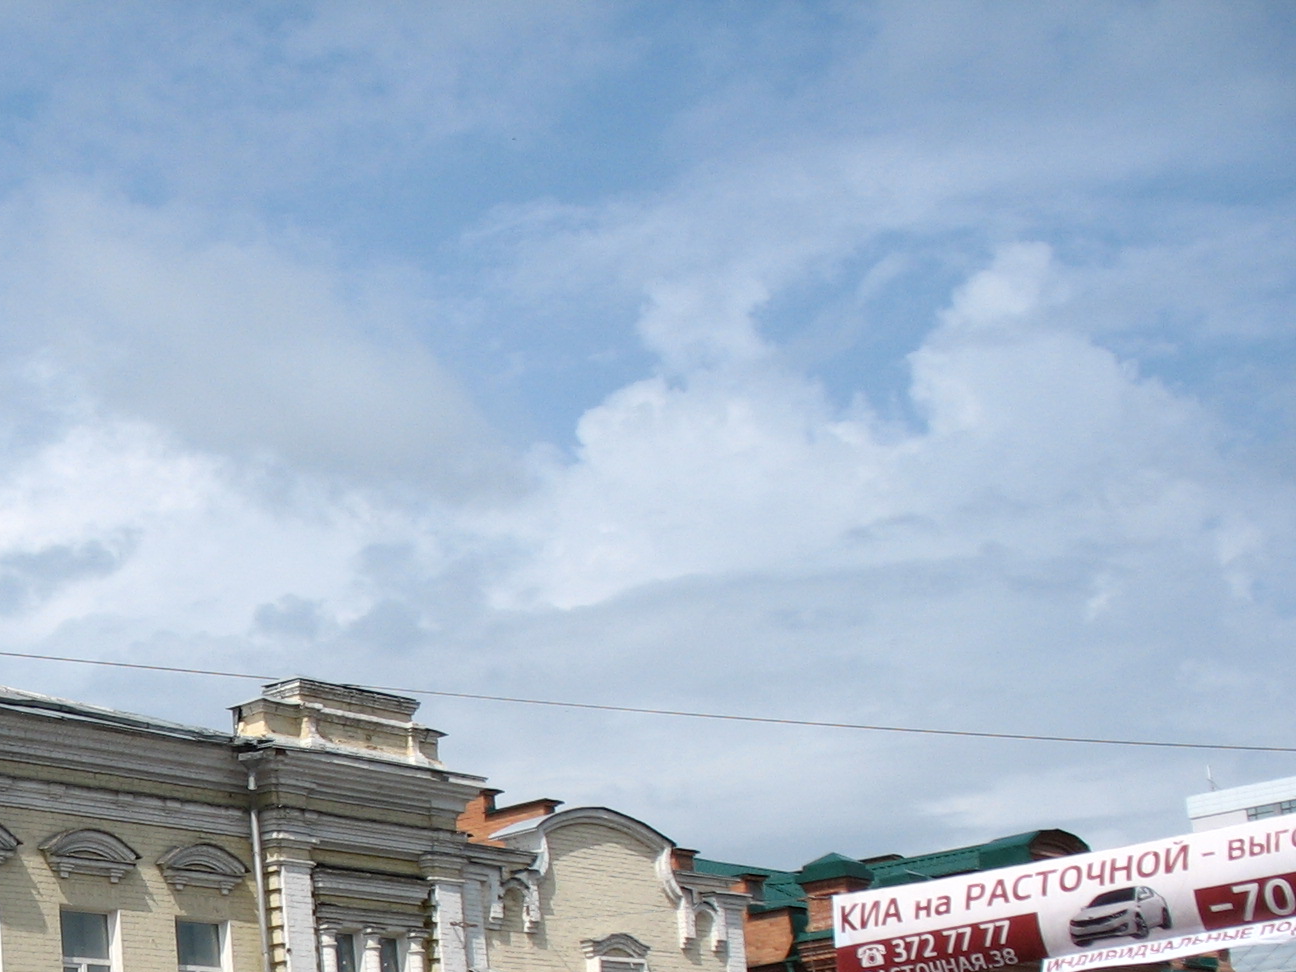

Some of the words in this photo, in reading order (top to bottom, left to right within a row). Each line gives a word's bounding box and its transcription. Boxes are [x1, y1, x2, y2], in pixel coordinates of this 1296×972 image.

[840, 897, 903, 933] КИА
[914, 894, 952, 920] на
[965, 840, 1191, 911] РАСТОЧНОЙ
[891, 934, 938, 963] 372
[942, 926, 973, 954] 77
[979, 920, 1011, 948] 77
